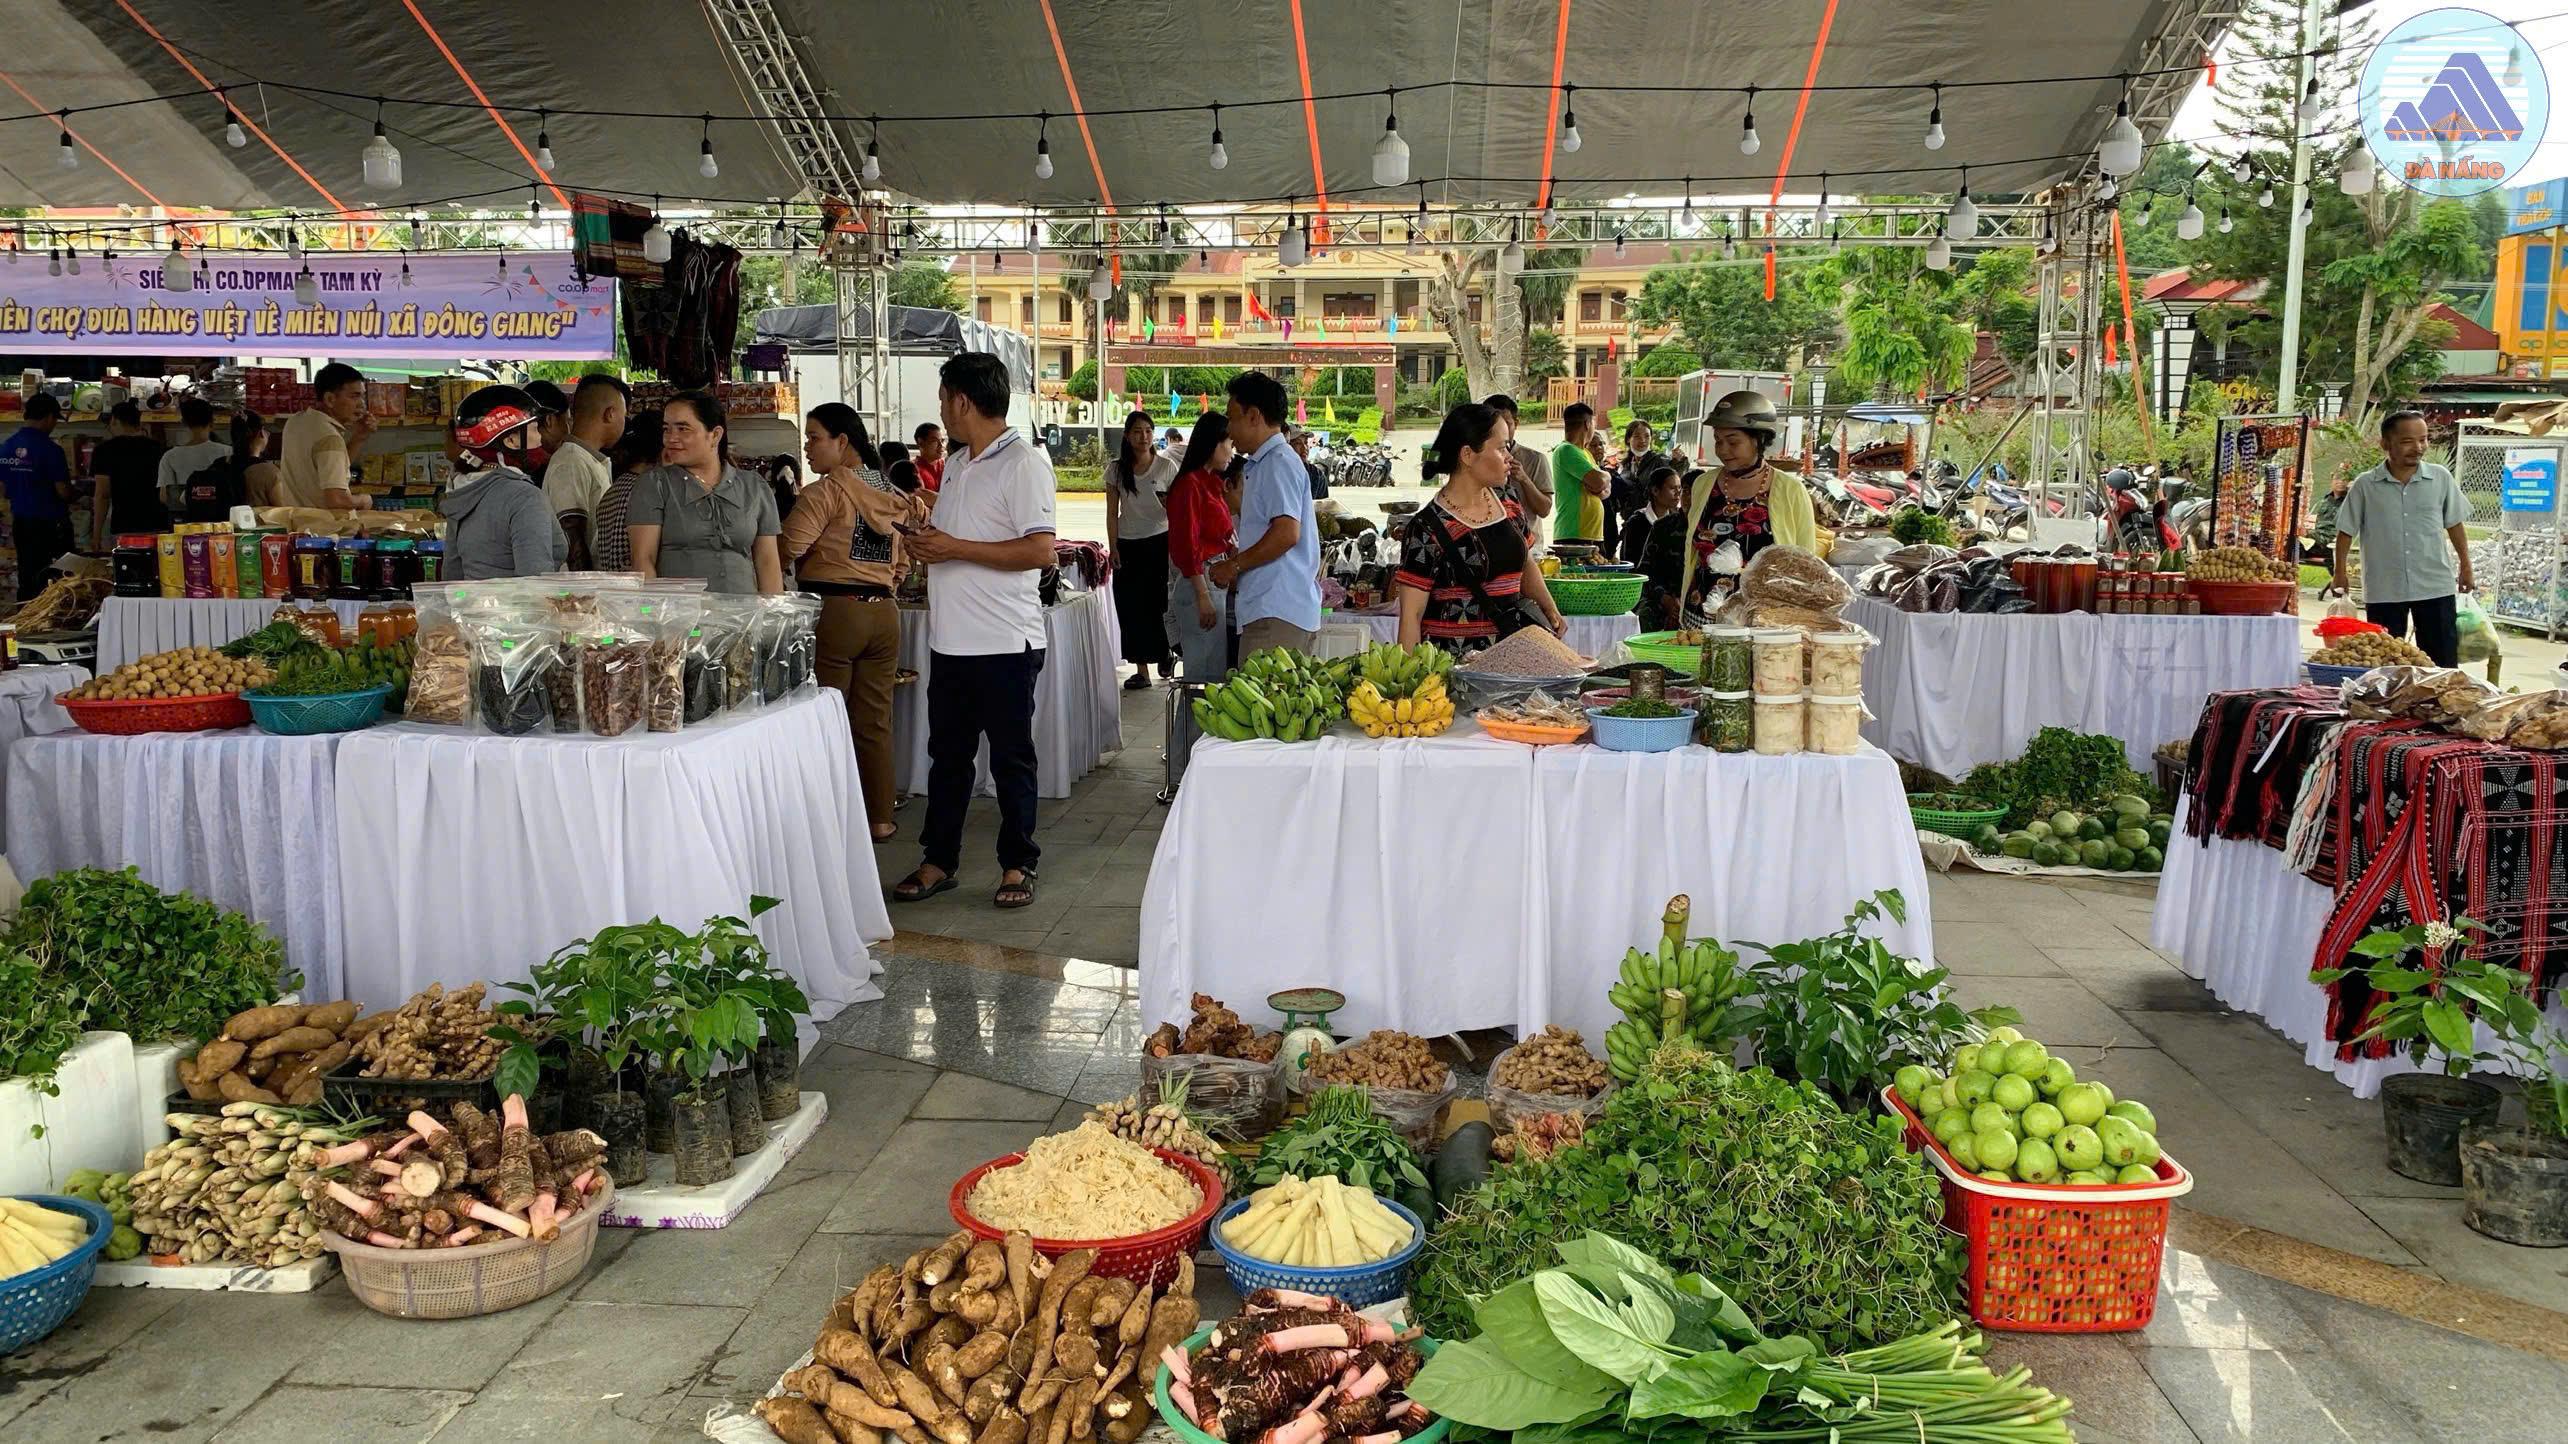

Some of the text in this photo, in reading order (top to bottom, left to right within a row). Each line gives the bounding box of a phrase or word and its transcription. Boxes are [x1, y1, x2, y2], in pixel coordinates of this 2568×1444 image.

[139, 266, 168, 290] SIÊ
[216, 270, 315, 290] CO.OPMA
[320, 271, 355, 291] TAM
[361, 268, 382, 291] KỲ
[36, 306, 84, 340] CHỢ
[87, 303, 132, 335] ĐƯA
[137, 298, 198, 336] HÀNG
[204, 300, 249, 341] VIỆT
[255, 297, 281, 336] VỀ
[346, 299, 384, 338] NÚI
[388, 303, 418, 337] XÃ
[423, 302, 488, 338] ĐÔNG
